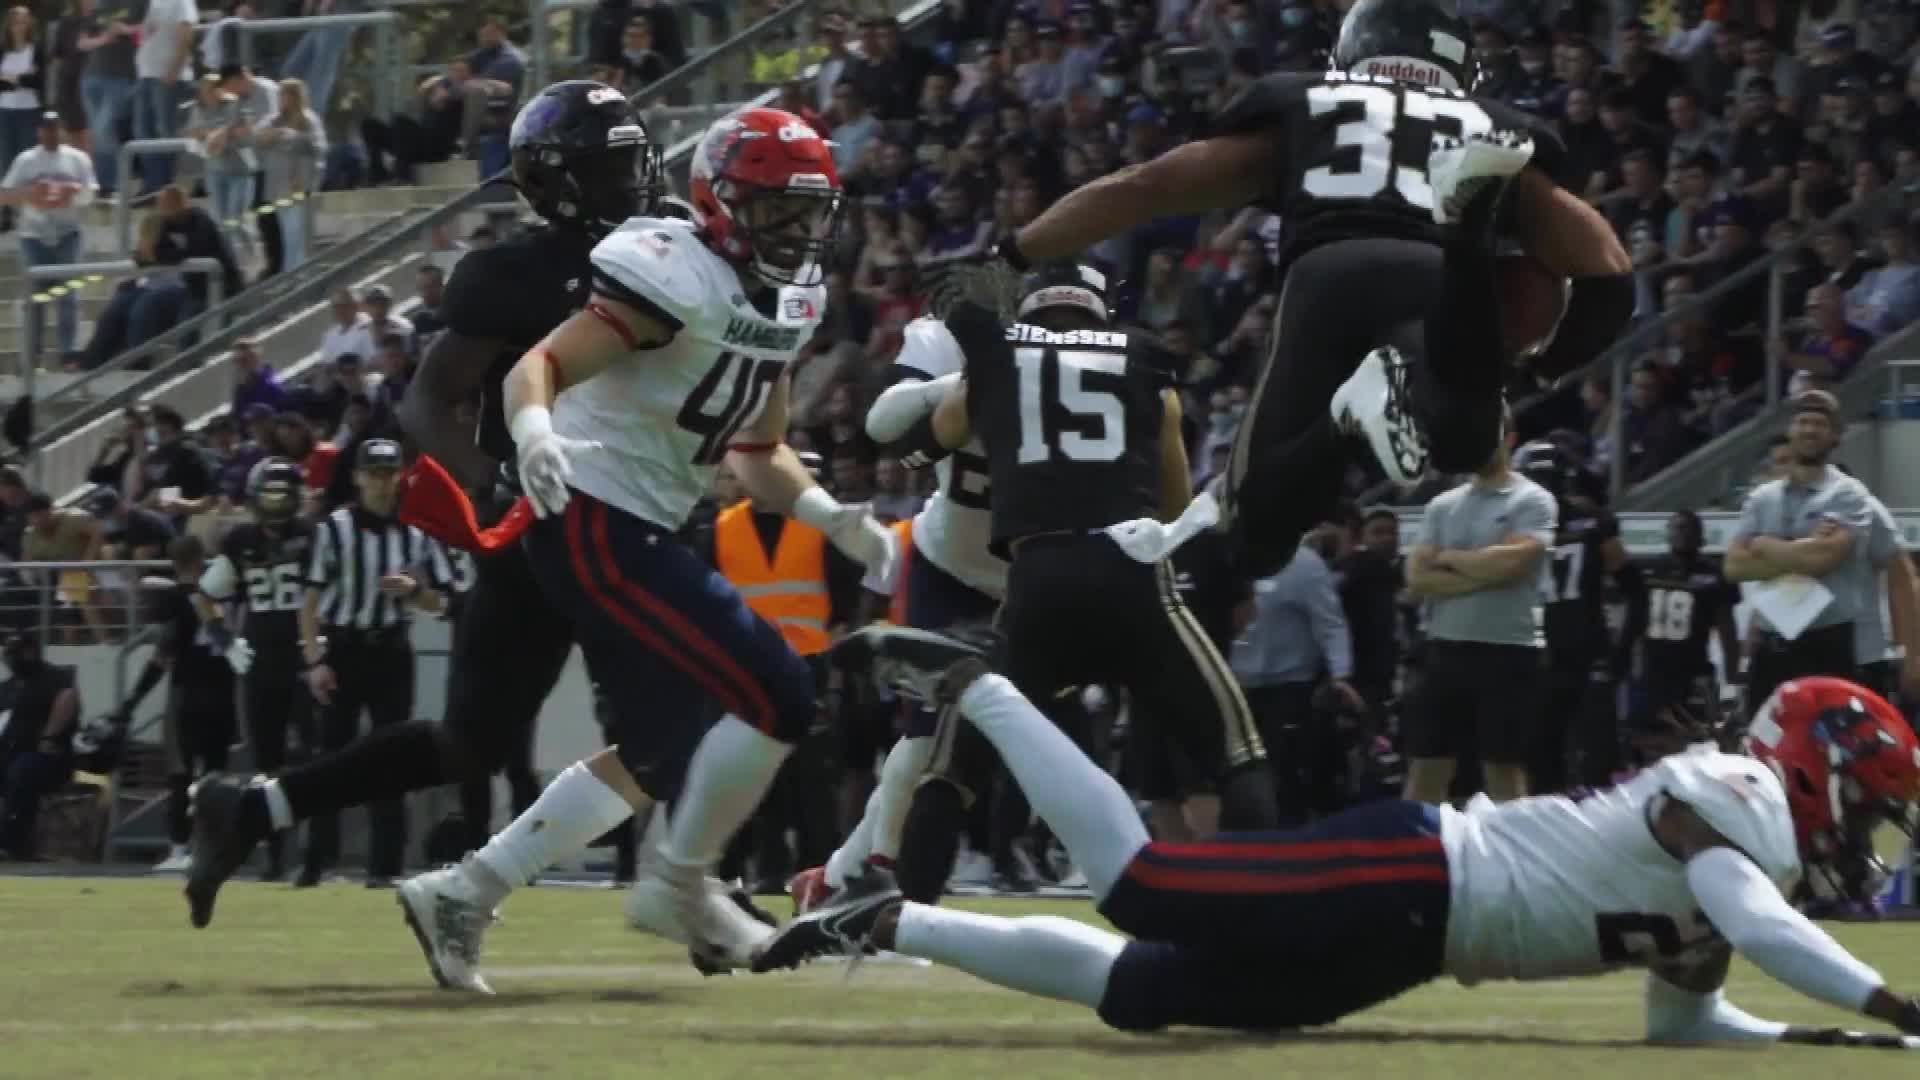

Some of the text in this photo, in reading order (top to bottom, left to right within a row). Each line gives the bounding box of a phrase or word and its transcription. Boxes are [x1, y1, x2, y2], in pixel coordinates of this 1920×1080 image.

[1014, 348, 1128, 464] 15
[244, 563, 304, 612] 26
[1647, 589, 1696, 641] 18
